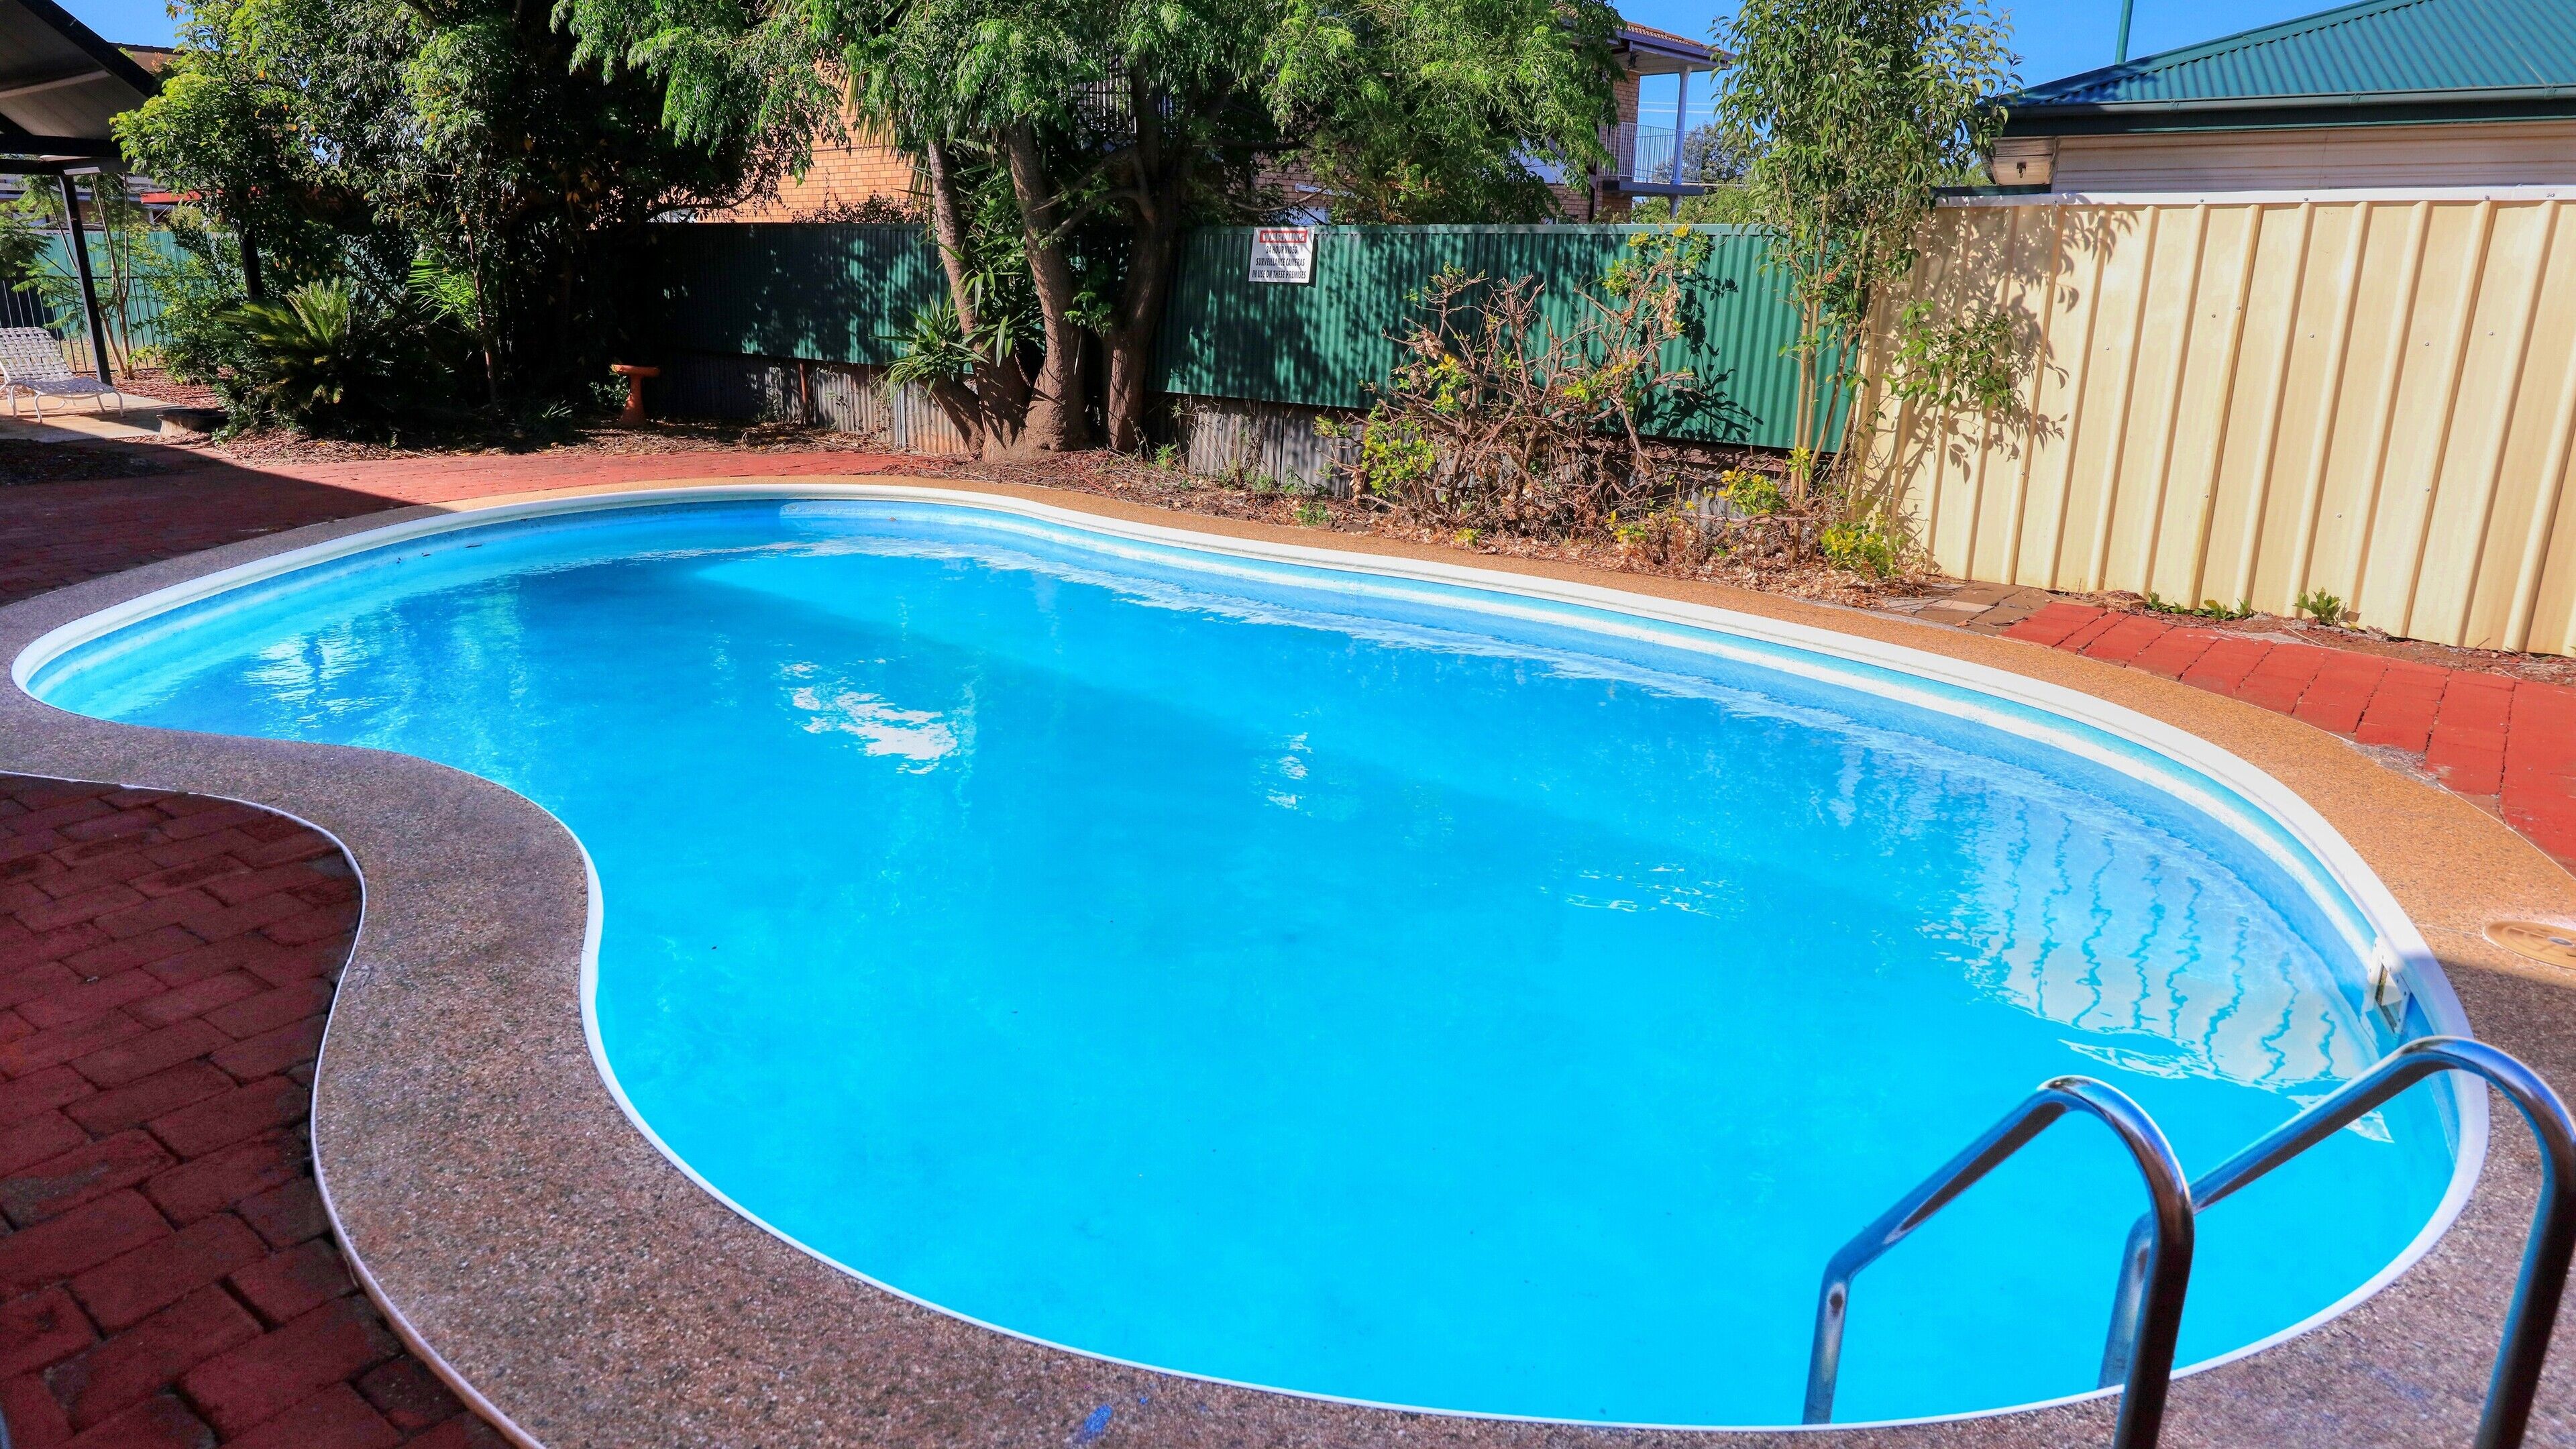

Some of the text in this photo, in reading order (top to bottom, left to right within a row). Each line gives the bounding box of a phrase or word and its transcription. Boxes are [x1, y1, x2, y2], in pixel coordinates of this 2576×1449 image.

[1263, 233, 1305, 241] WARNING
[1272, 246, 1284, 254] HOUR
[1285, 246, 1298, 254] VIDEO
[1256, 258, 1305, 266] SURVEILLANCE CAMERAS
[1252, 270, 1256, 278] IN
[1266, 270, 1272, 278] ON
[1273, 270, 1285, 278] THESE
[1285, 270, 1306, 279] PREMISES
